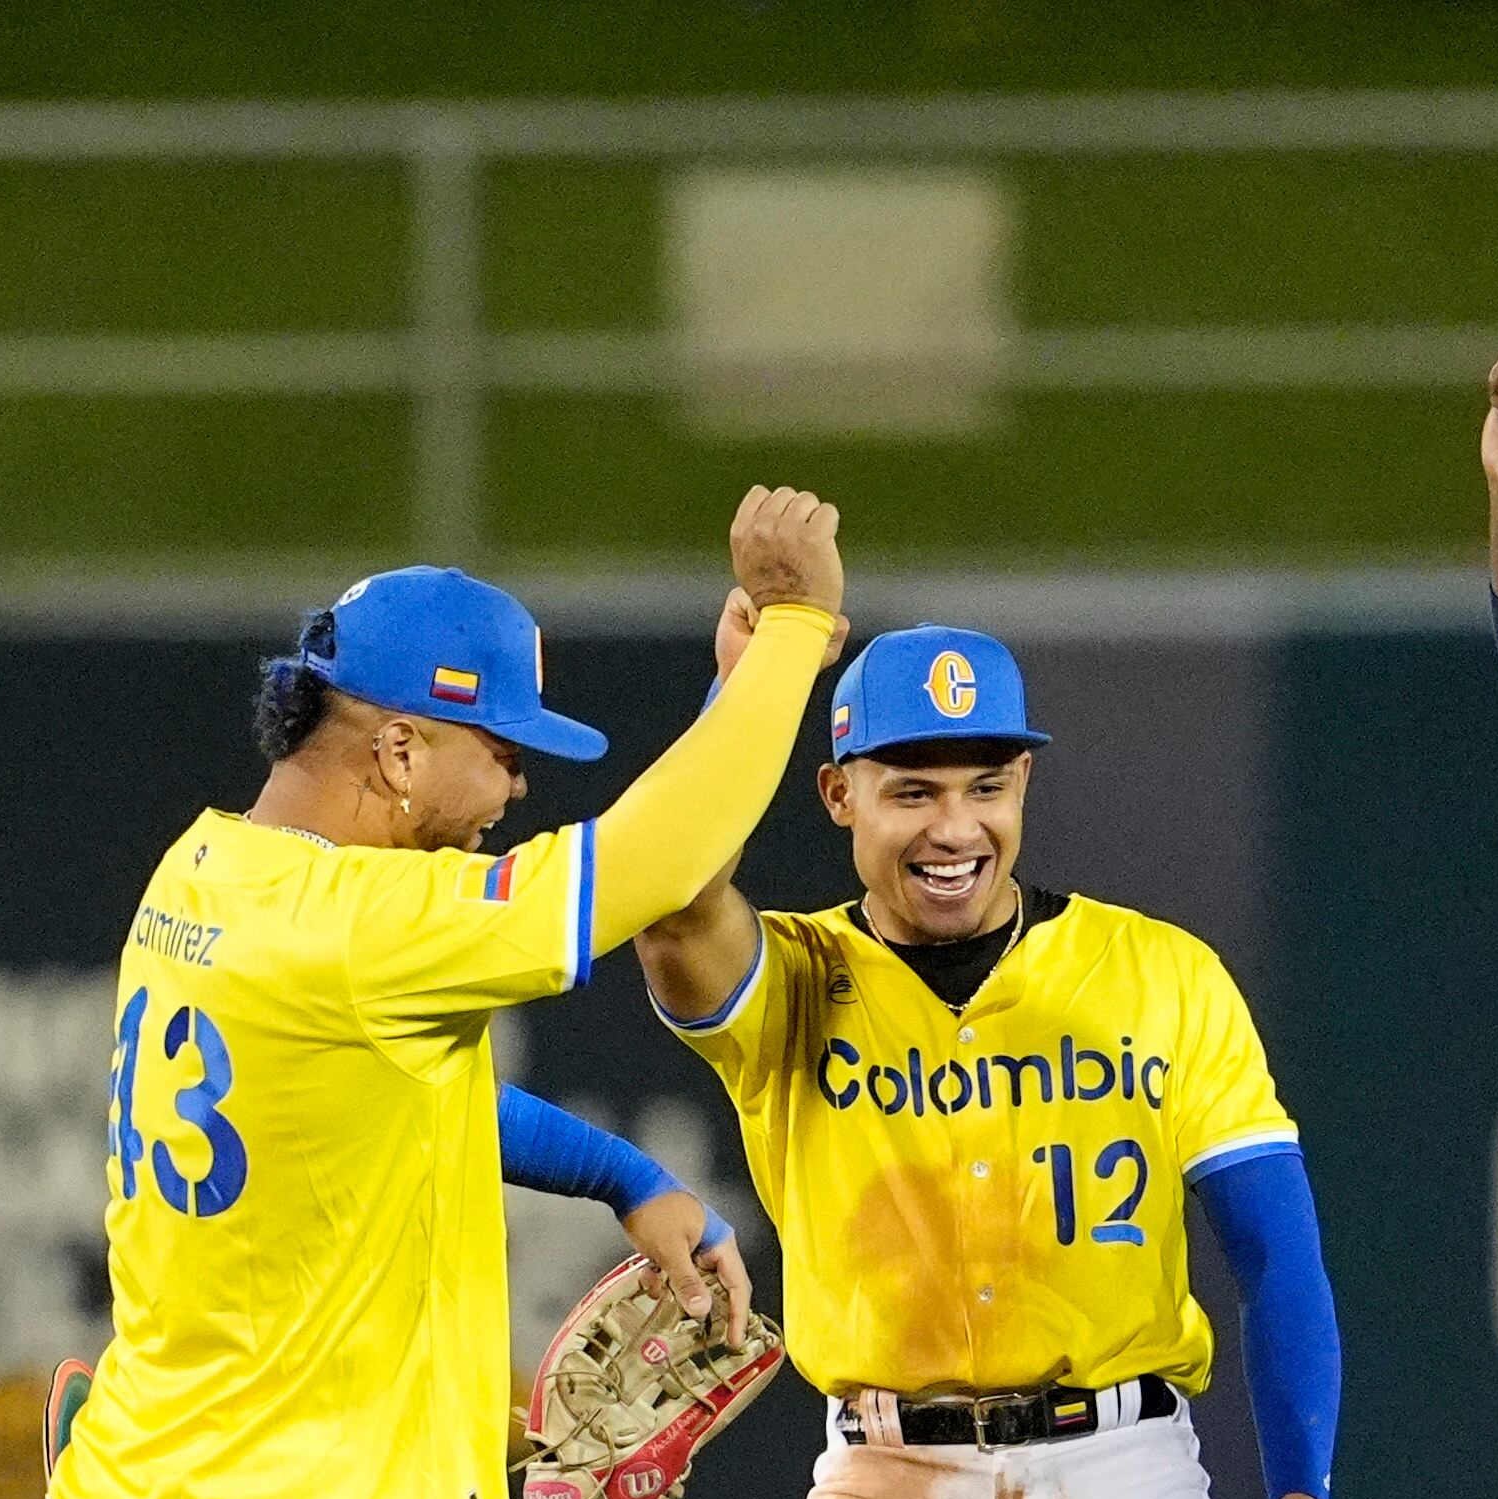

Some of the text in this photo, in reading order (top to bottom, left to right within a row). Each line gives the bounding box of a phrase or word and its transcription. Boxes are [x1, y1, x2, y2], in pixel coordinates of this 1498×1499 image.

[922, 650, 977, 719] C
[131, 905, 223, 967] amirez
[108, 985, 248, 1218] 43
[817, 1034, 1171, 1117] Colombia
[1032, 1139, 1149, 1246] 12
